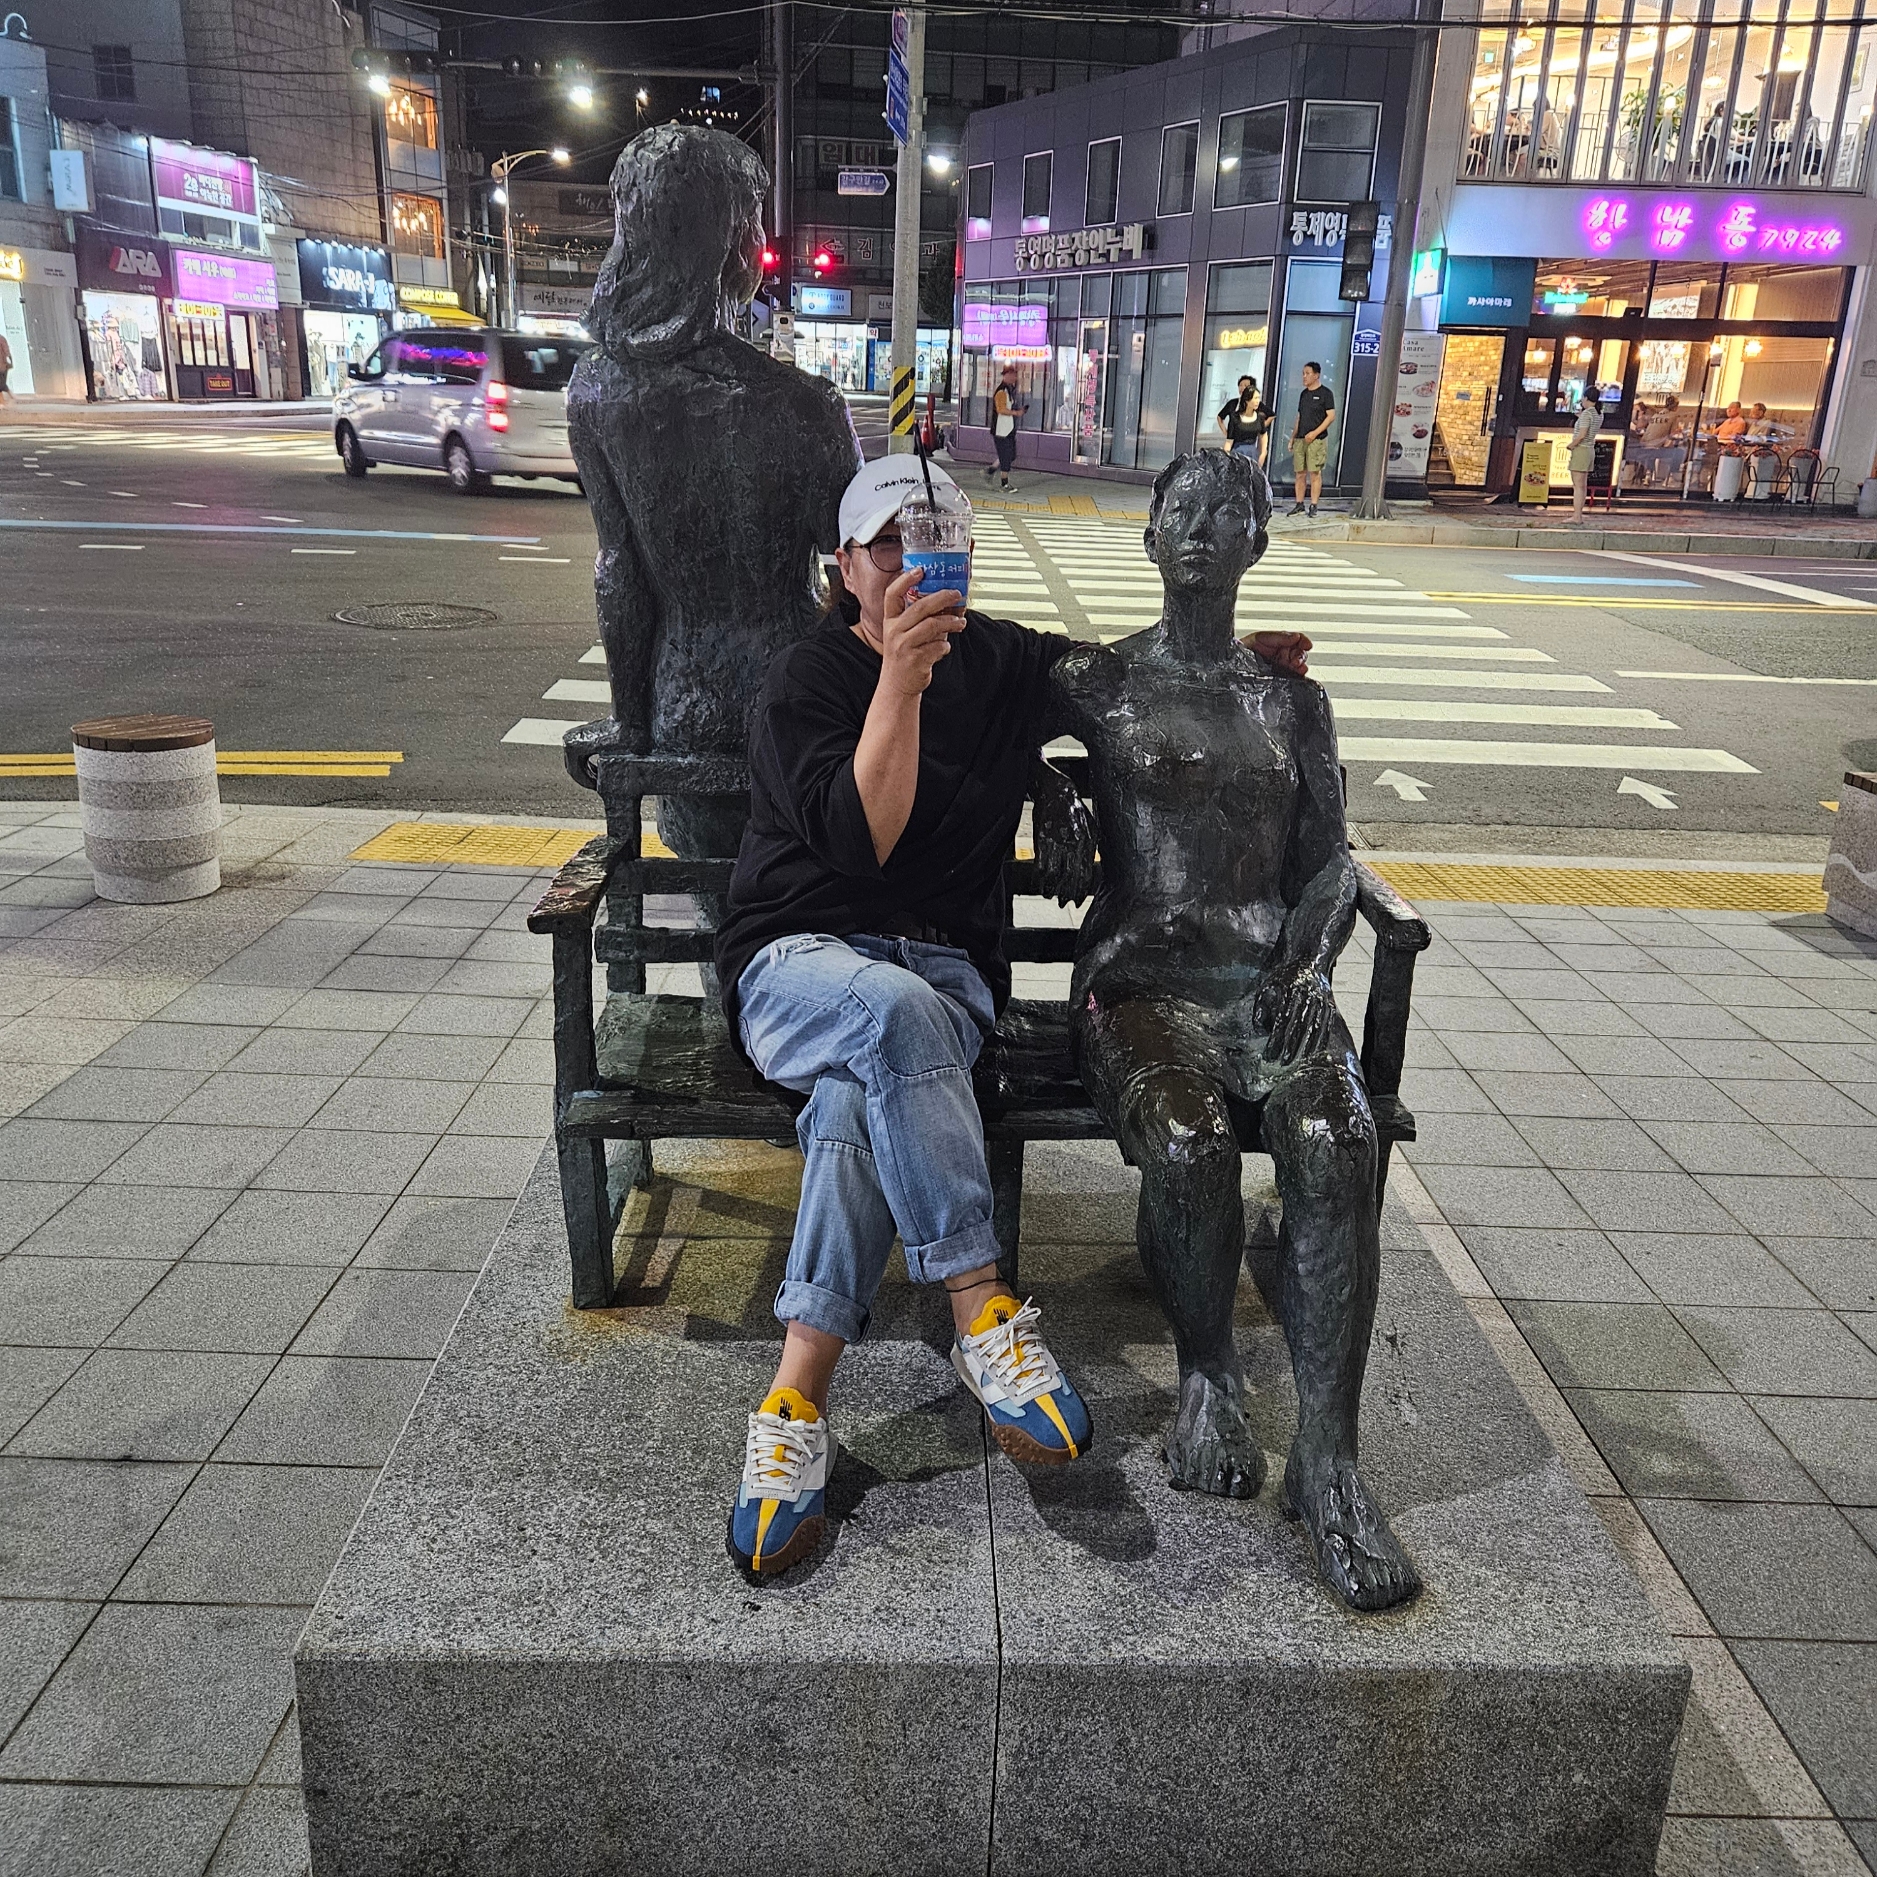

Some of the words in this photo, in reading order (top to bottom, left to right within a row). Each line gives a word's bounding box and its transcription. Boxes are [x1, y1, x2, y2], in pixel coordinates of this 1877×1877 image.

[822, 142, 877, 165] 임대
[1290, 211, 1392, 249] 통제영품
[858, 238, 939, 260] 김과
[1015, 223, 1144, 271] 통영명품장인누비
[111, 247, 162, 277] ARA
[400, 287, 434, 302] COMPOSE
[1354, 342, 1380, 353] 315-2
[209, 380, 220, 388] TAKE
[221, 380, 230, 388] OUT
[874, 479, 899, 491] Calvin
[900, 477, 919, 485] Klein
